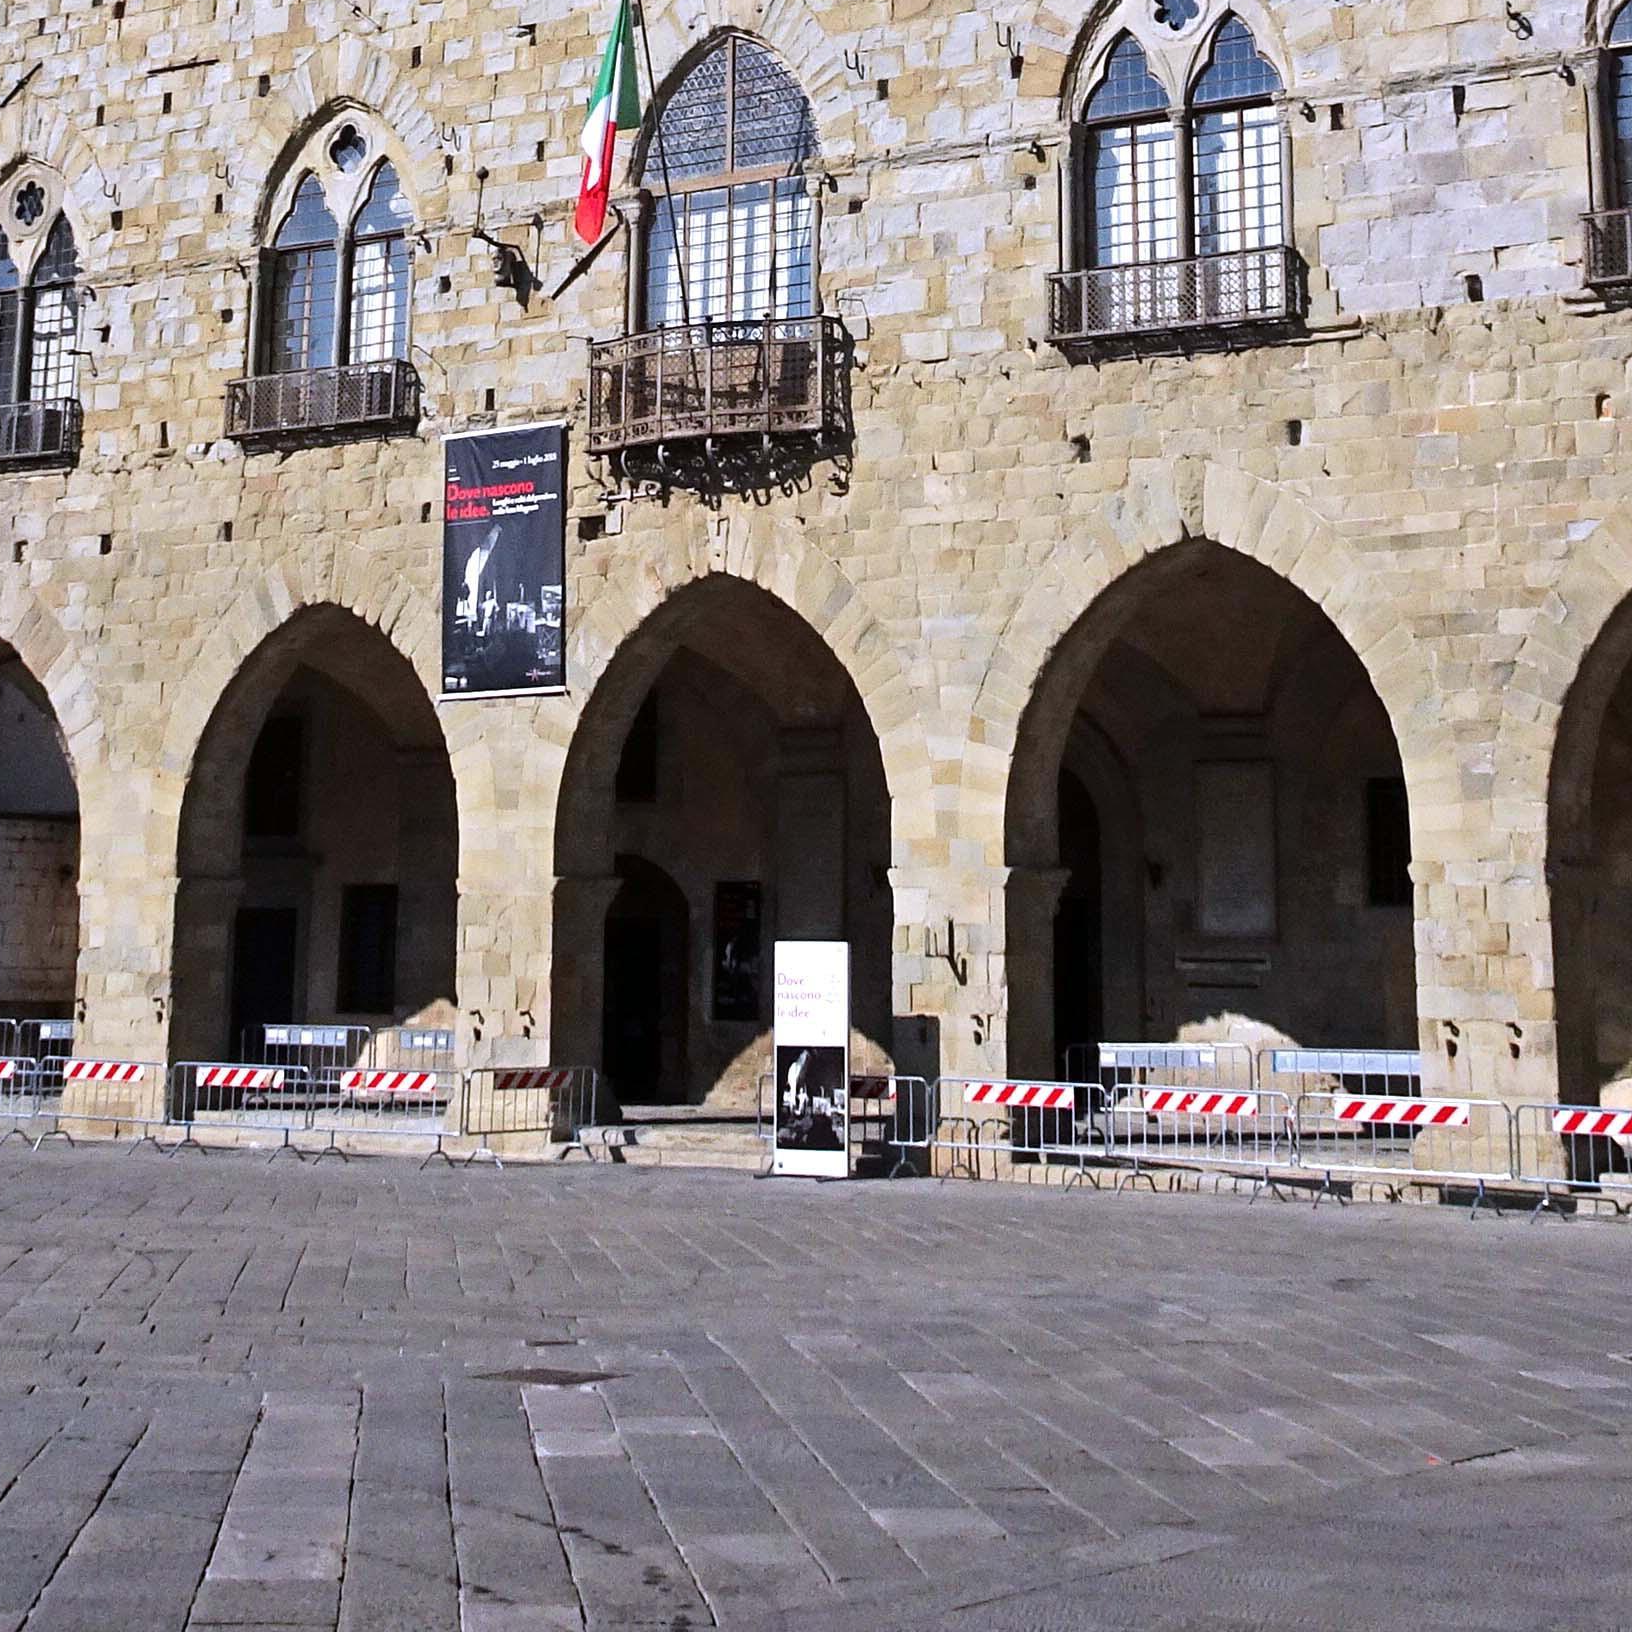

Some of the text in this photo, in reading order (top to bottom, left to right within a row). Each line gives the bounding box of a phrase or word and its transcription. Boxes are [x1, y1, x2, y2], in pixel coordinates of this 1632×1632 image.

[447, 481, 534, 500] Dove nascono
[447, 503, 458, 520] le
[777, 972, 805, 986] Dove
[777, 990, 822, 1001] nascono
